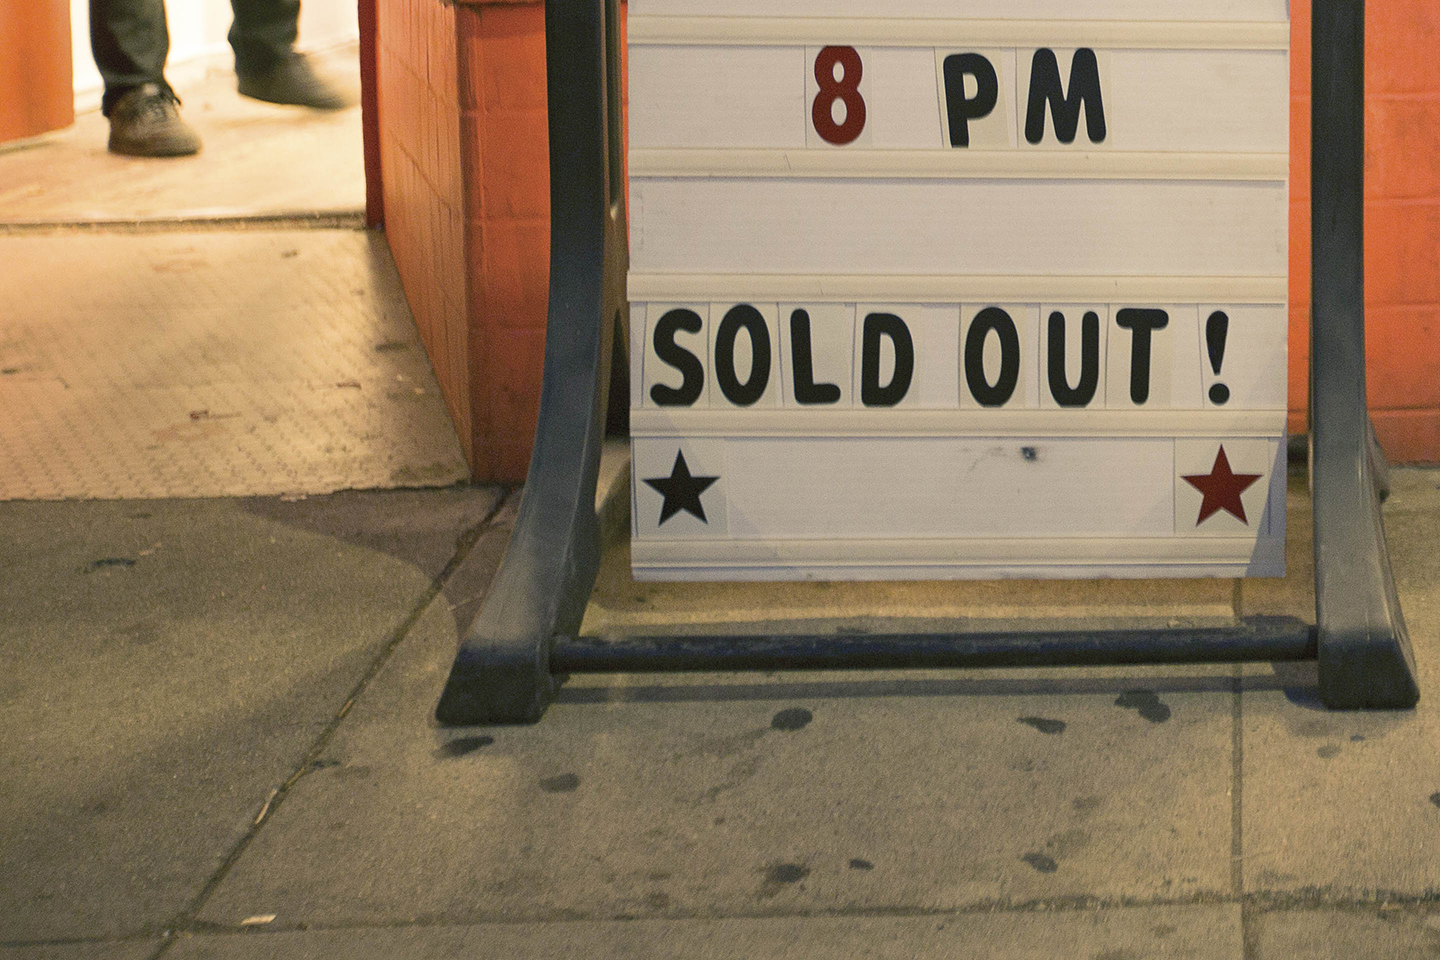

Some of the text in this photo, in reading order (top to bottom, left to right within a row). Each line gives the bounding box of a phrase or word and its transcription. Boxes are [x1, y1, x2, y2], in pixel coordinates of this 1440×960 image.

[811, 44, 1107, 148] 8 PM
[649, 304, 914, 407] SOLD
